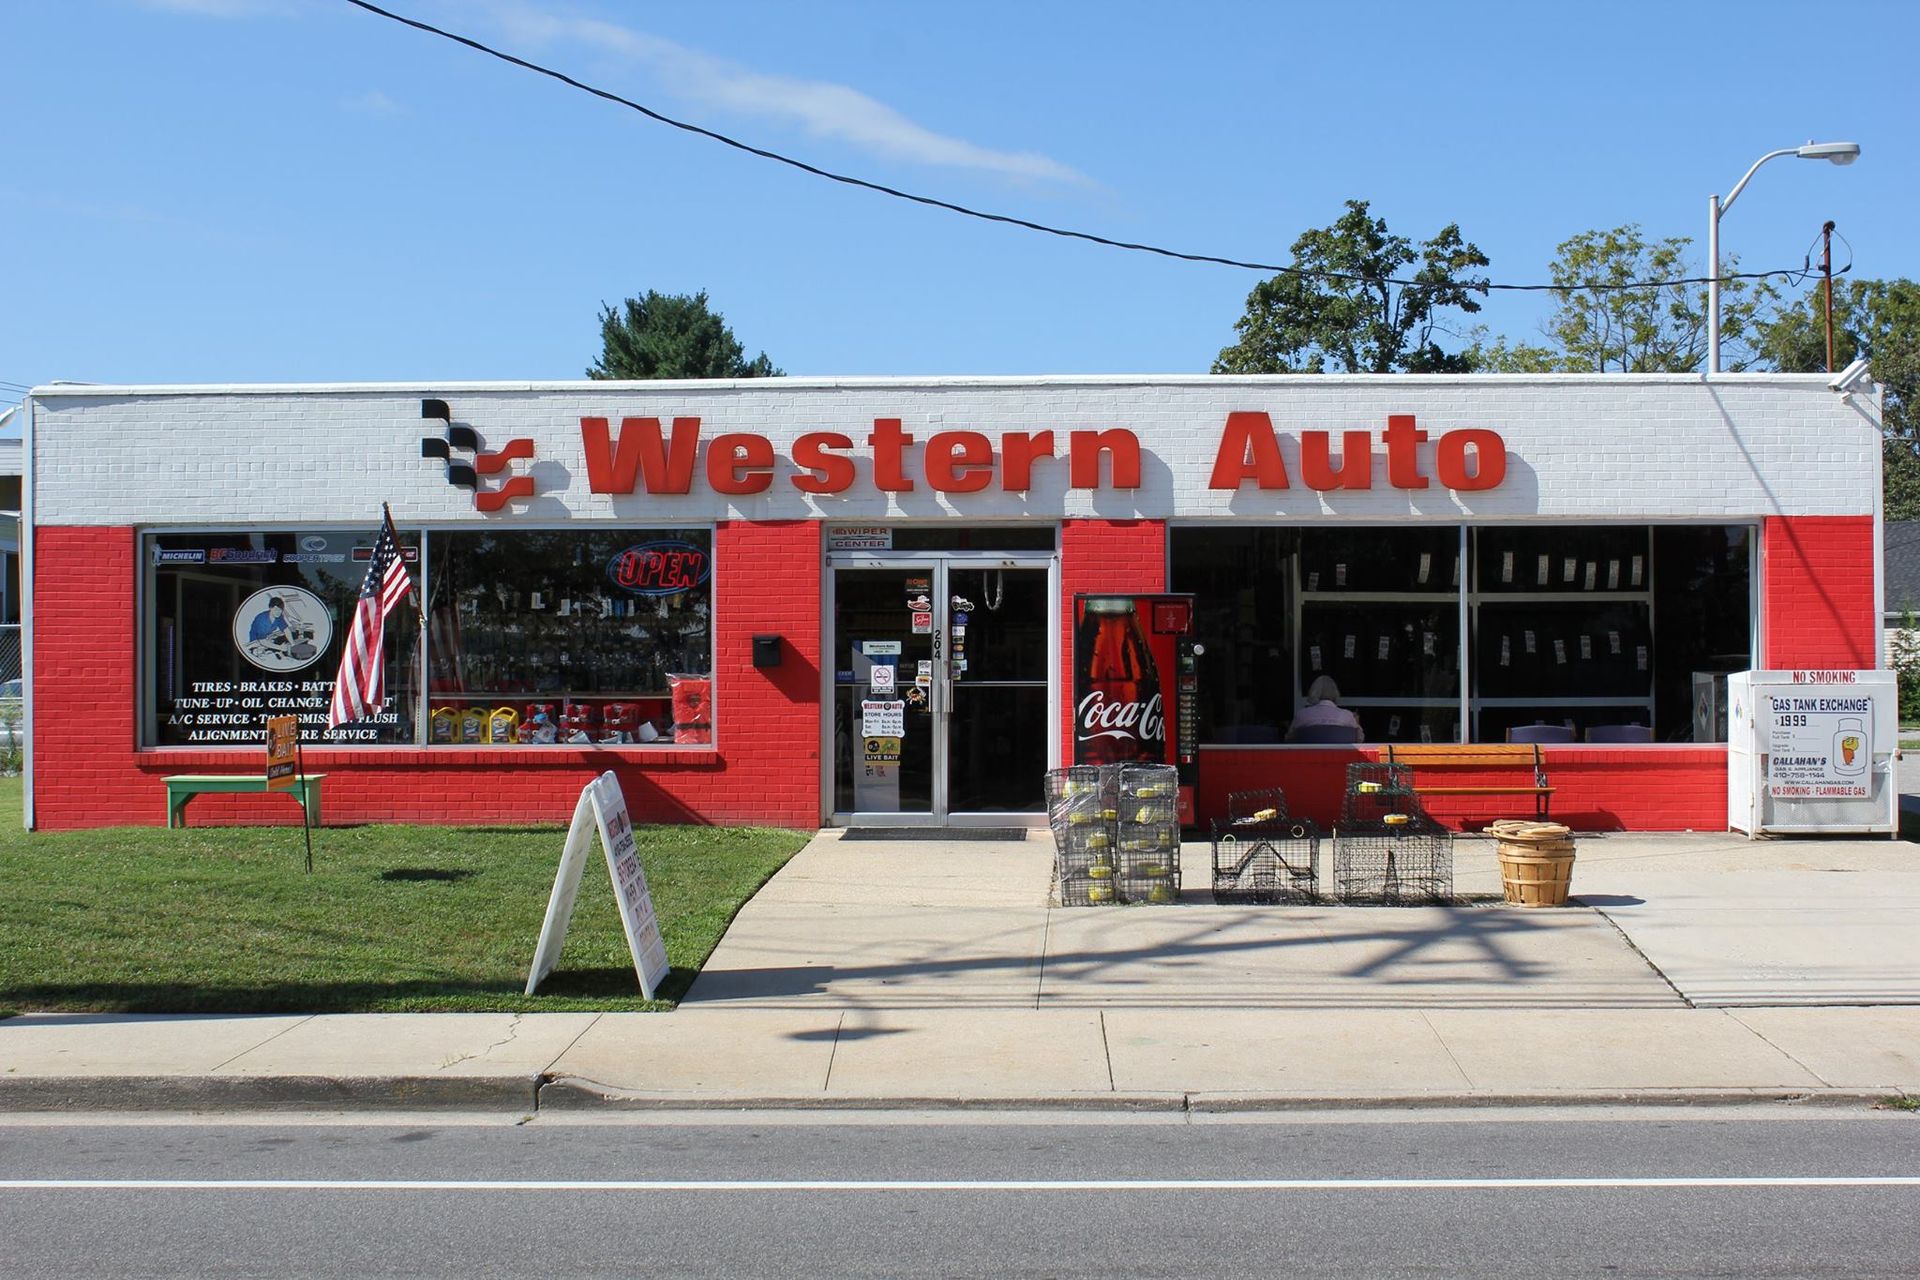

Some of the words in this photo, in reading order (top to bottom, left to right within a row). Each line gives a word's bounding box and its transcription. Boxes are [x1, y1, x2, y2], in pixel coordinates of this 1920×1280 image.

[580, 416, 1141, 495] Western
[1208, 411, 1507, 491] Auto
[161, 552, 203, 560] MICHELIN
[617, 551, 702, 588] OPEN
[1792, 671, 1806, 683] NO
[1809, 671, 1856, 683] SMOKING
[192, 682, 232, 692] TIRES
[240, 682, 293, 692] BRAKES
[302, 682, 337, 692] BATT
[175, 698, 233, 708] TUNE-UP
[242, 698, 264, 708] OIL
[268, 698, 324, 708] CHANGE
[1772, 699, 1791, 711] GAS
[1793, 699, 1817, 711] TANK
[1820, 699, 1868, 711] EXCHANGE
[168, 713, 194, 725] A/C
[196, 713, 250, 724] SERVICE
[188, 729, 268, 740] ALIGNMENT
[322, 729, 378, 740] SERVICE
[1773, 757, 1827, 765] CALLAHAN'S
[1772, 786, 1780, 795] NO
[1782, 786, 1811, 795] SMOKING
[1815, 786, 1853, 795] FLAMMABLE
[1853, 786, 1866, 795] GAS
